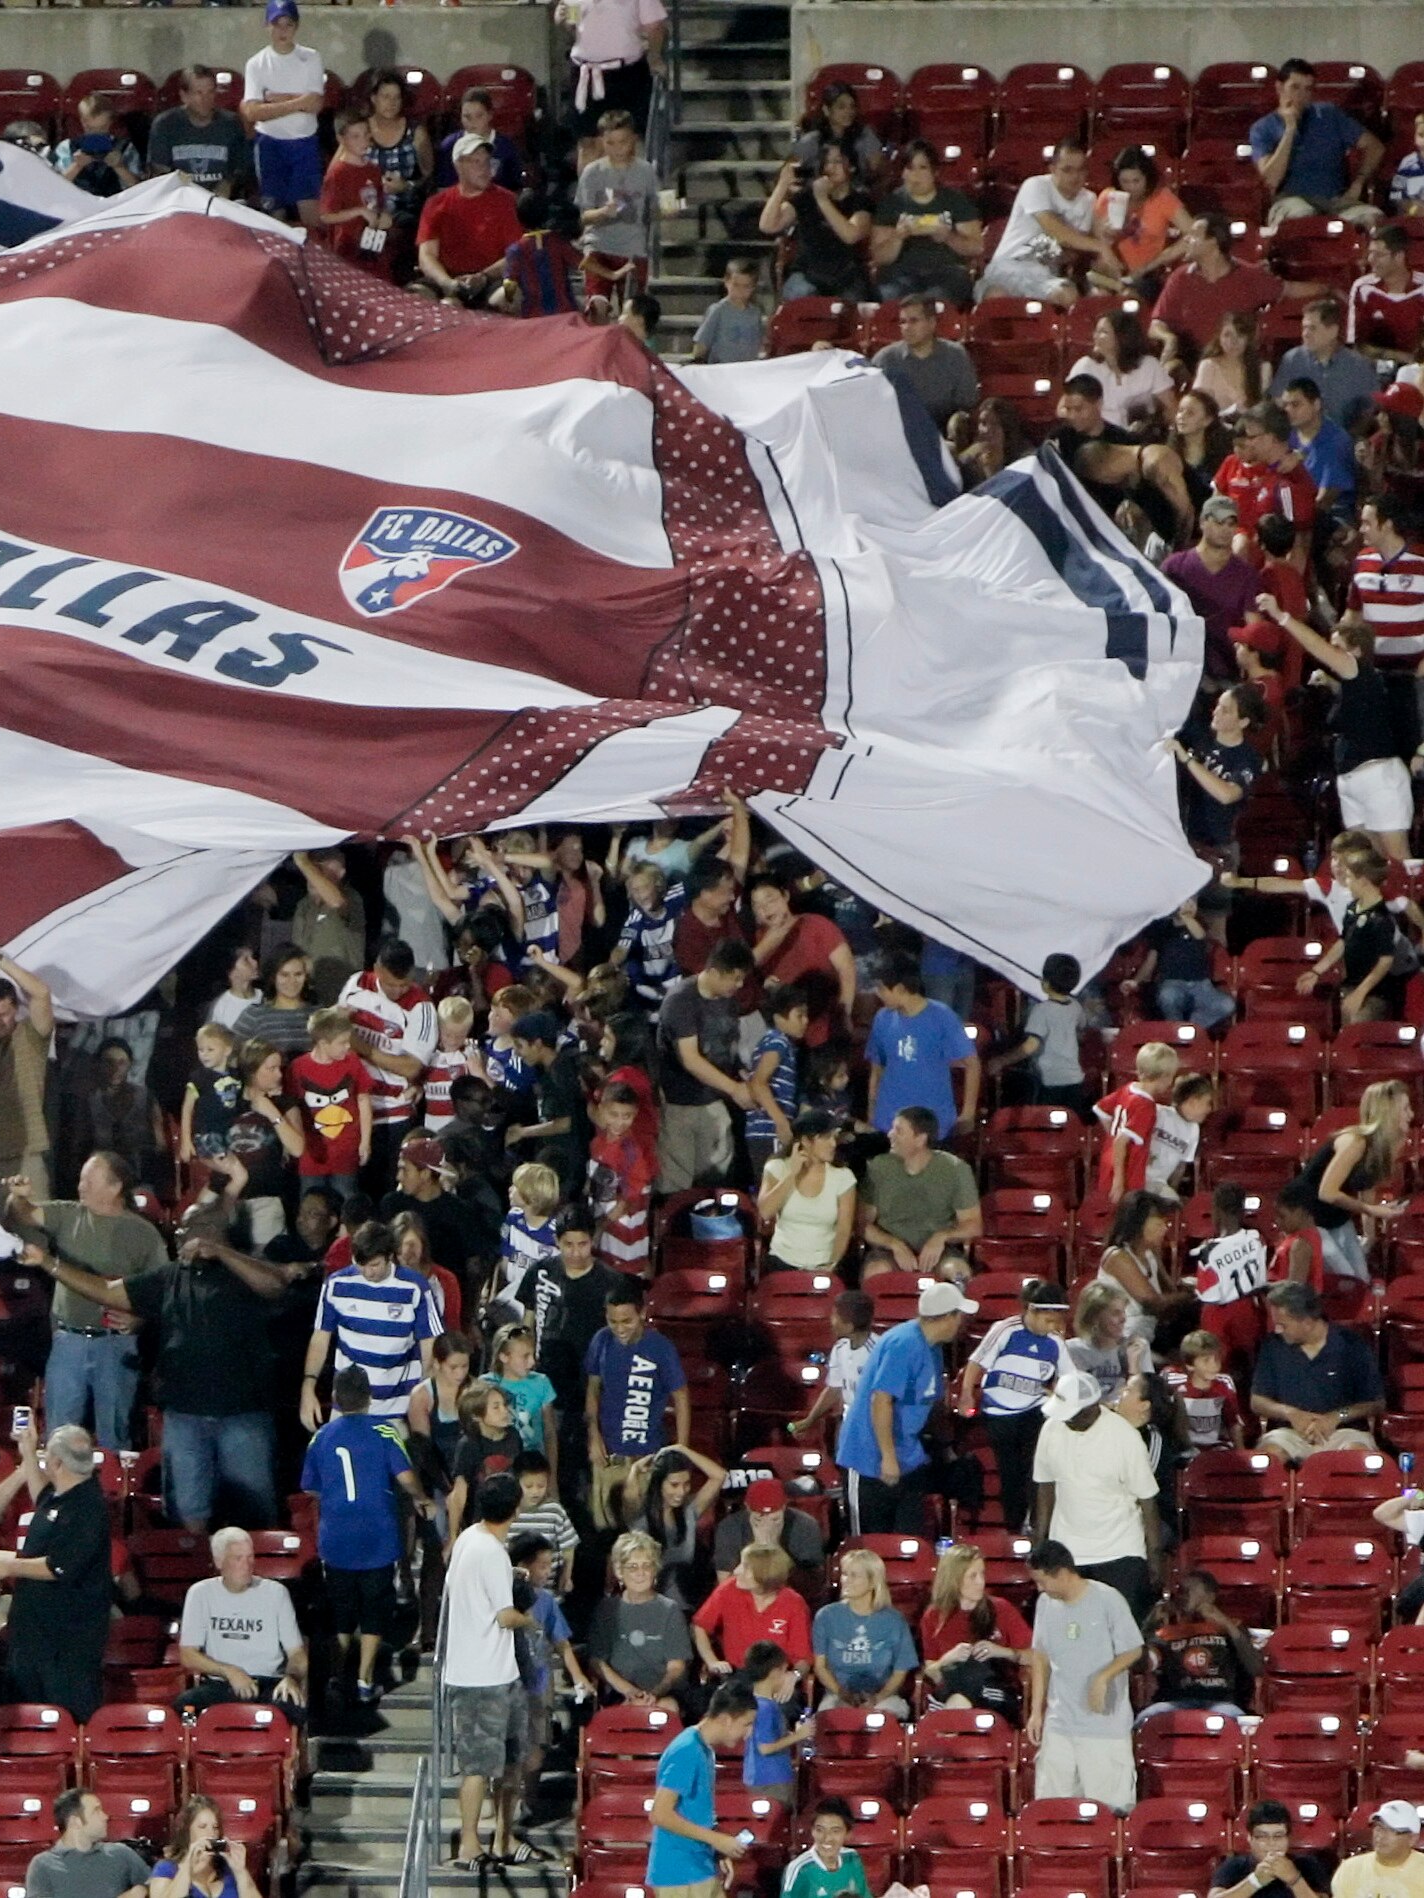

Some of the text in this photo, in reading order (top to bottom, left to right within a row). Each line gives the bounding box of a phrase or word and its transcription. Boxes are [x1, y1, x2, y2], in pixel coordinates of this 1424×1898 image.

[371, 514, 504, 558] FC DALLAS
[335, 1446, 356, 1502] 1
[211, 1616, 263, 1633] TEXANS
[1187, 1651, 1206, 1668] 46
